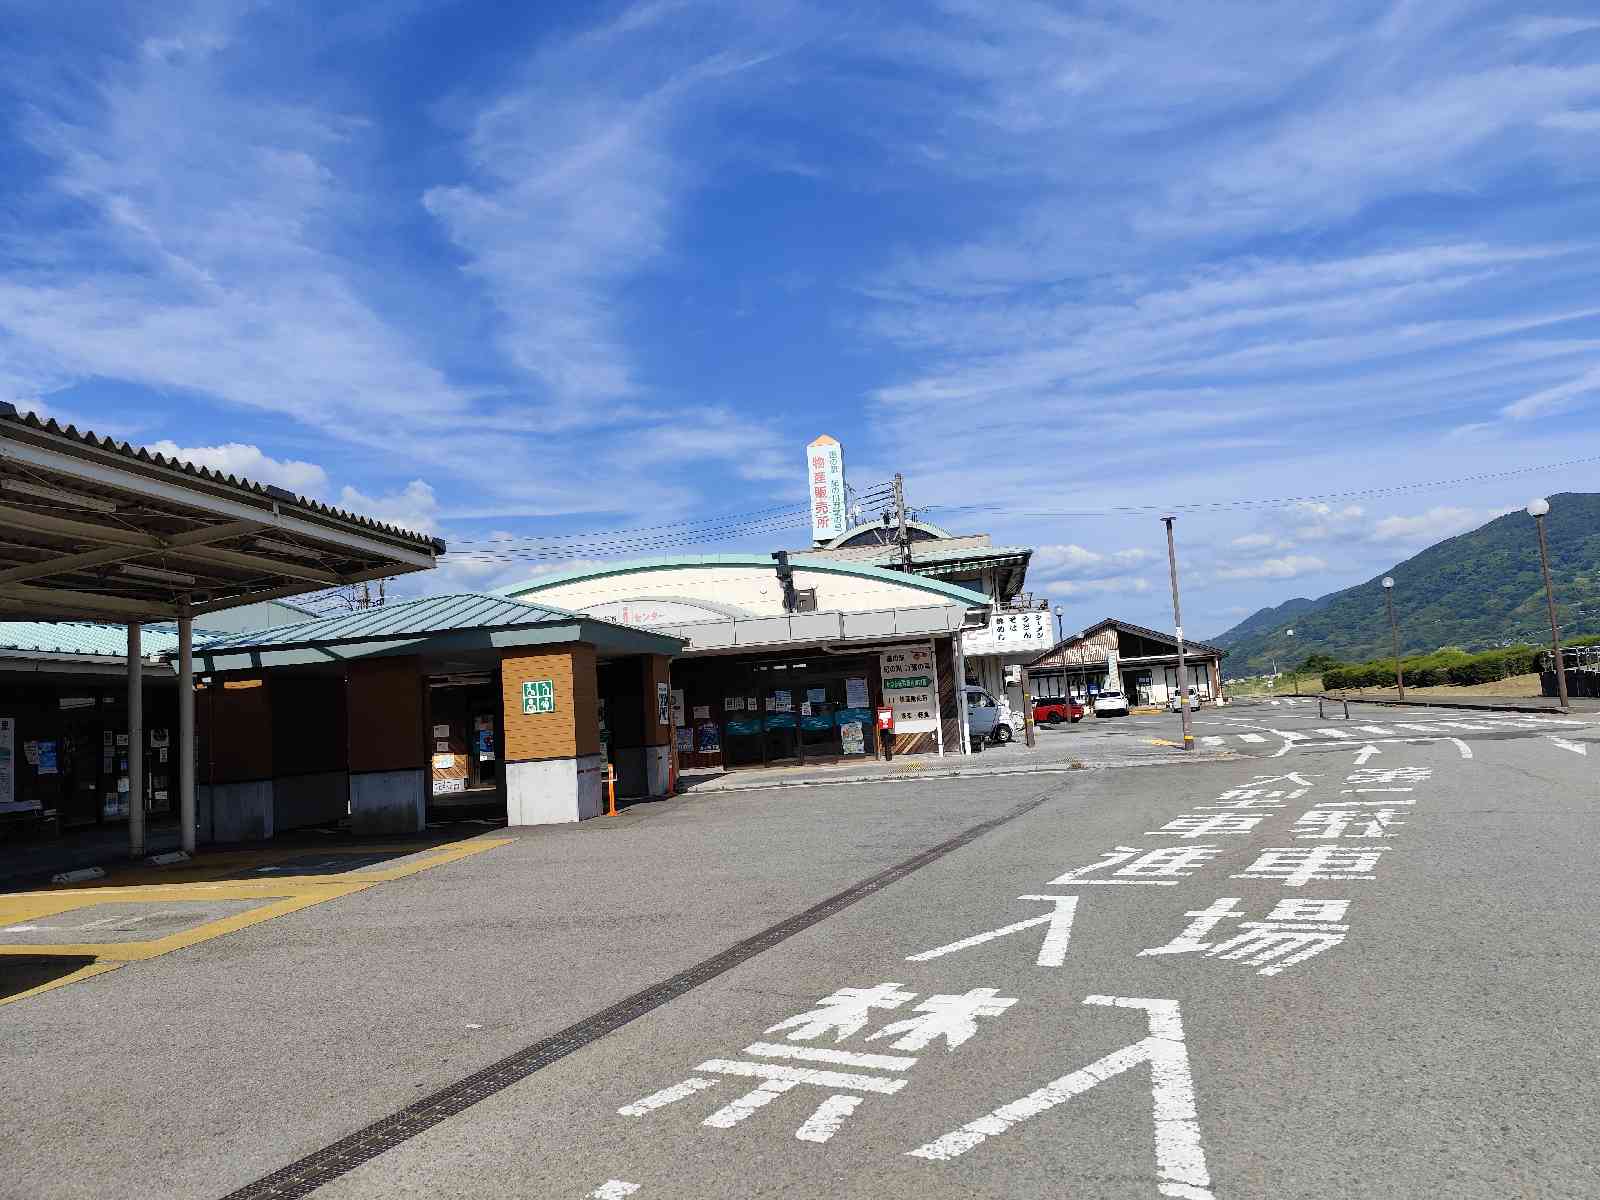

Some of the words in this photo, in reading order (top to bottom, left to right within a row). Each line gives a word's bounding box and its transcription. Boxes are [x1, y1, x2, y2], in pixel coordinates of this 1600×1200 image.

[812, 455, 829, 529] 物産販売所
[1023, 615, 1032, 639] うどん
[592, 771, 1326, 1200] 大型車進入禁
